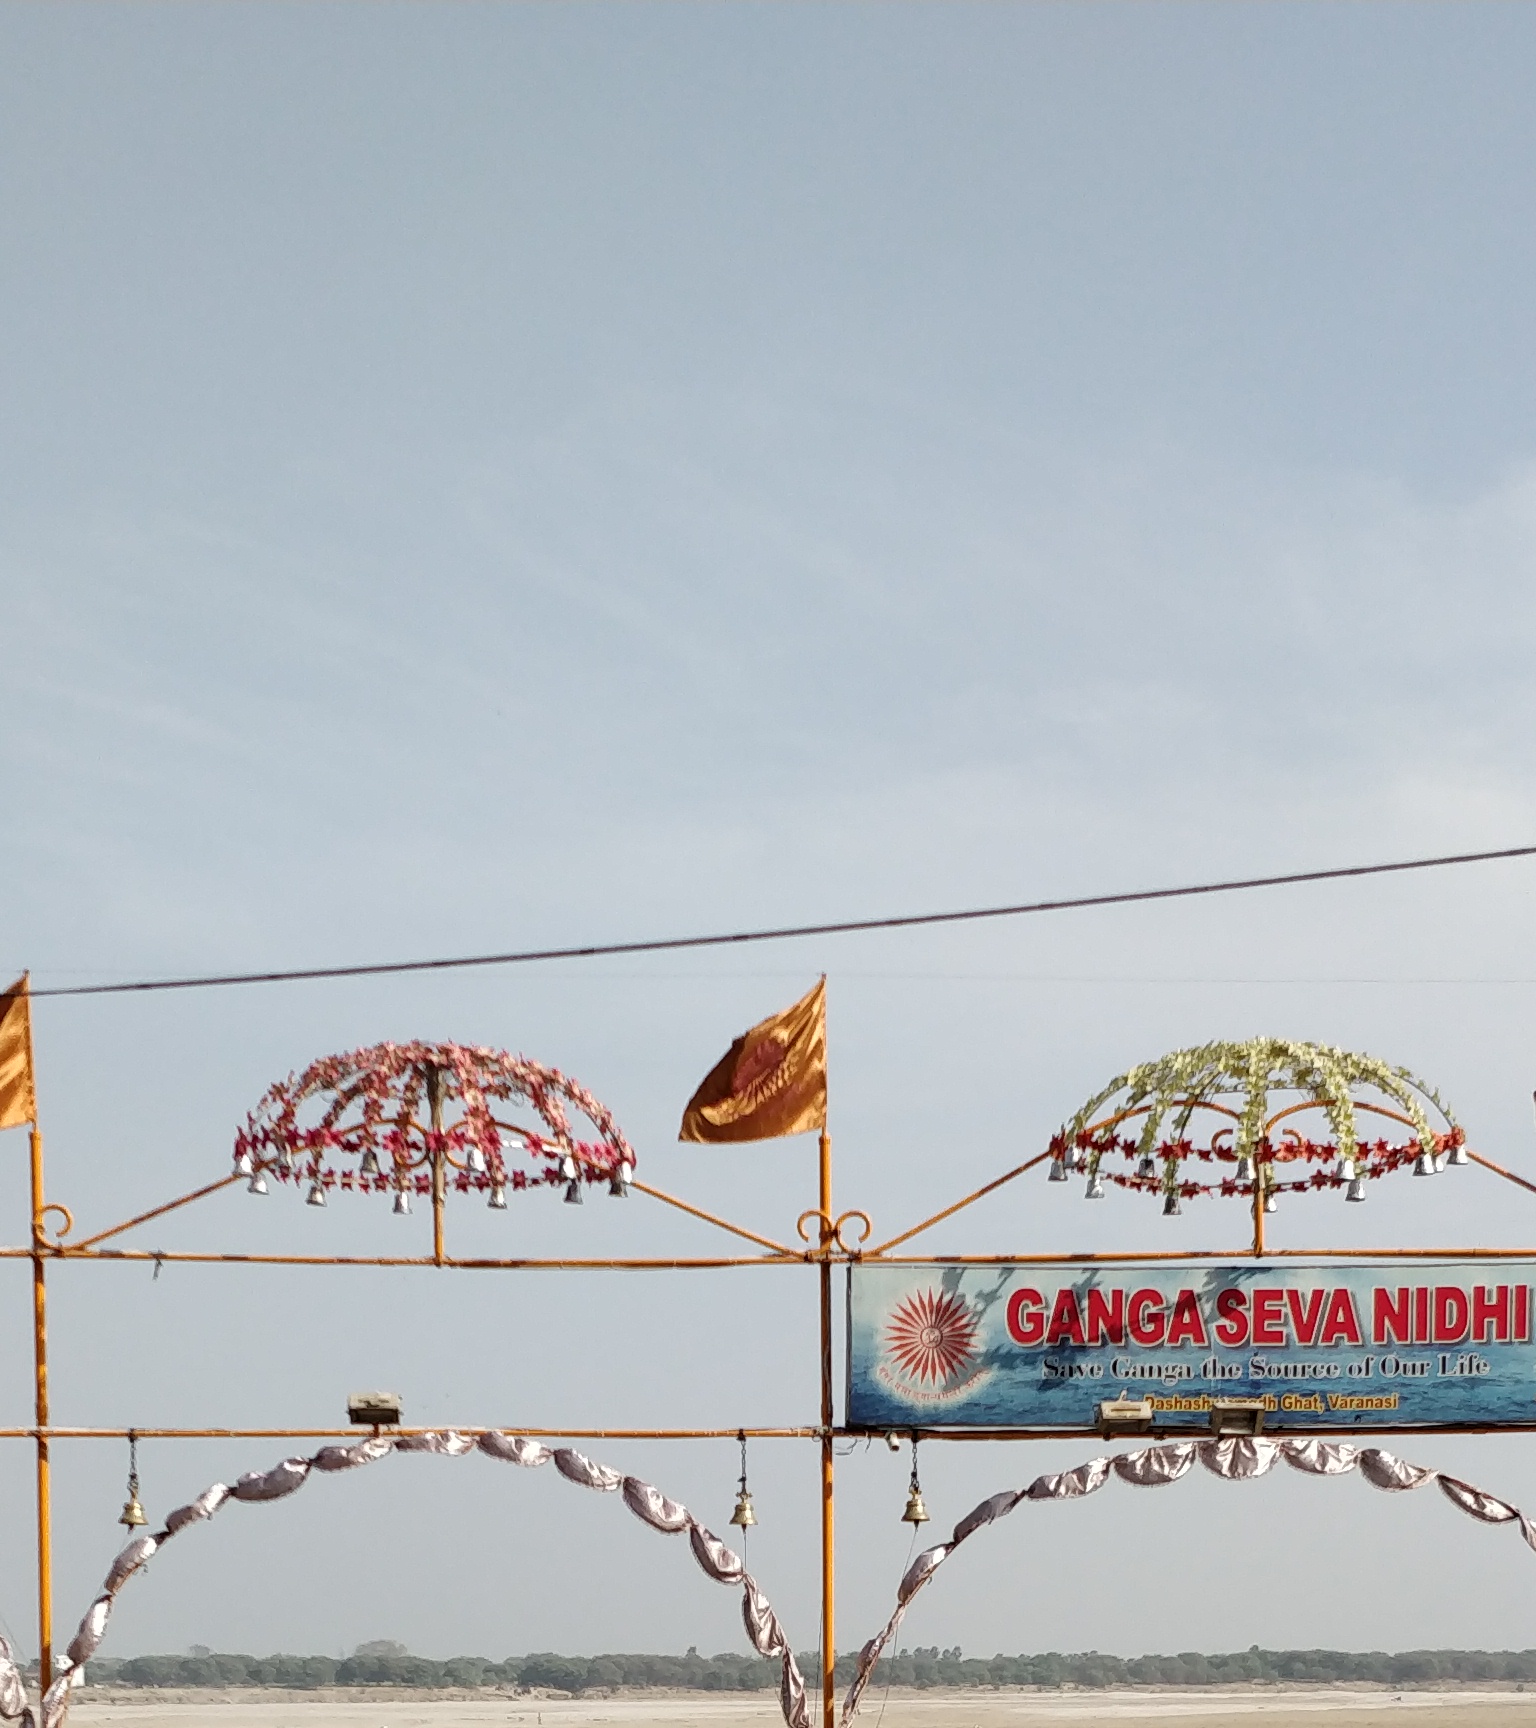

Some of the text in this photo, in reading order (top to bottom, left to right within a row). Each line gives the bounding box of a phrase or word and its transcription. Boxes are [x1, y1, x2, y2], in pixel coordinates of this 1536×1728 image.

[1005, 1283, 1531, 1346] GANGA SEVA NIDHI
[1042, 1351, 1491, 1385] Save Ganga the Source of Our Life
[1282, 1394, 1324, 1415] Ghat,
[1329, 1393, 1399, 1411] Varanasi
